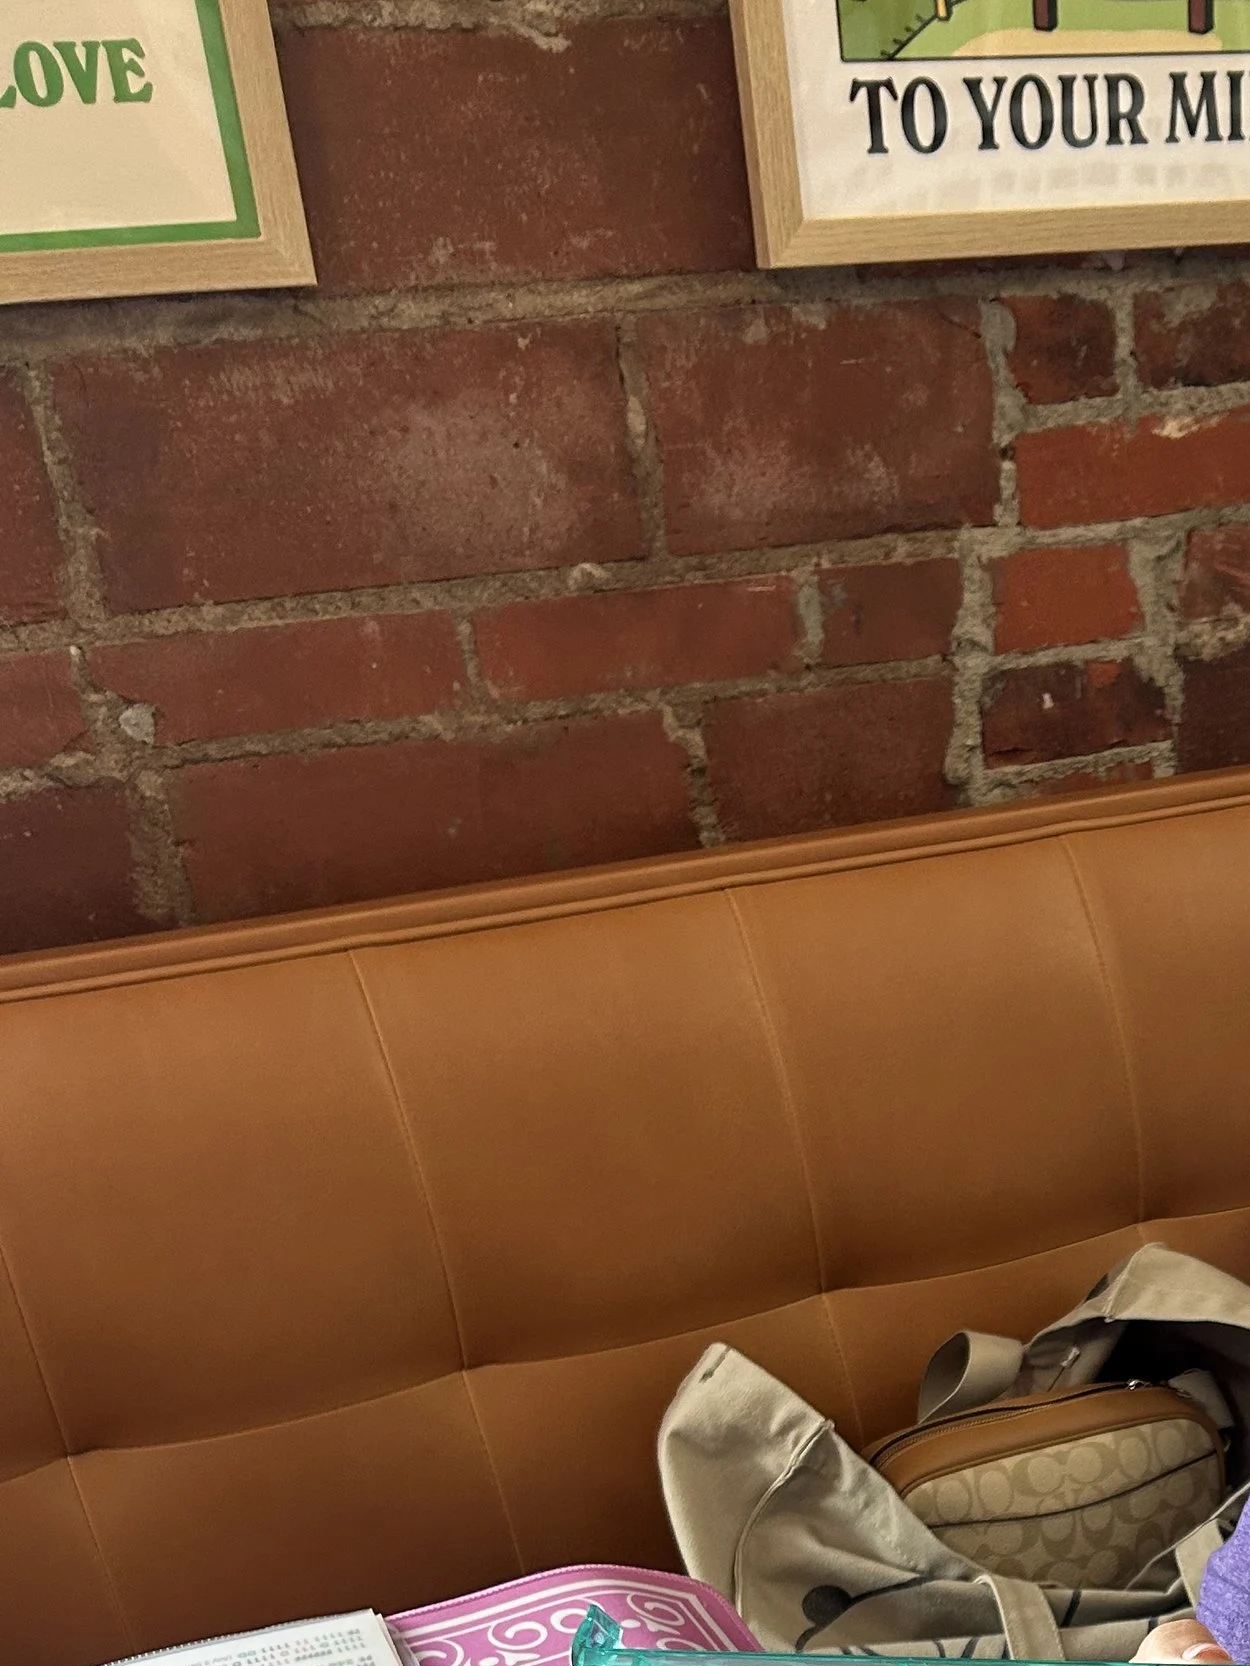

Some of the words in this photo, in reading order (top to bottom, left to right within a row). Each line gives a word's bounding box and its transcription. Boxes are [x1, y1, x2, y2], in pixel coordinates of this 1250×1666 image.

[0, 38, 153, 108] OVE
[850, 76, 949, 154] TO
[963, 72, 1149, 152] YOUR
